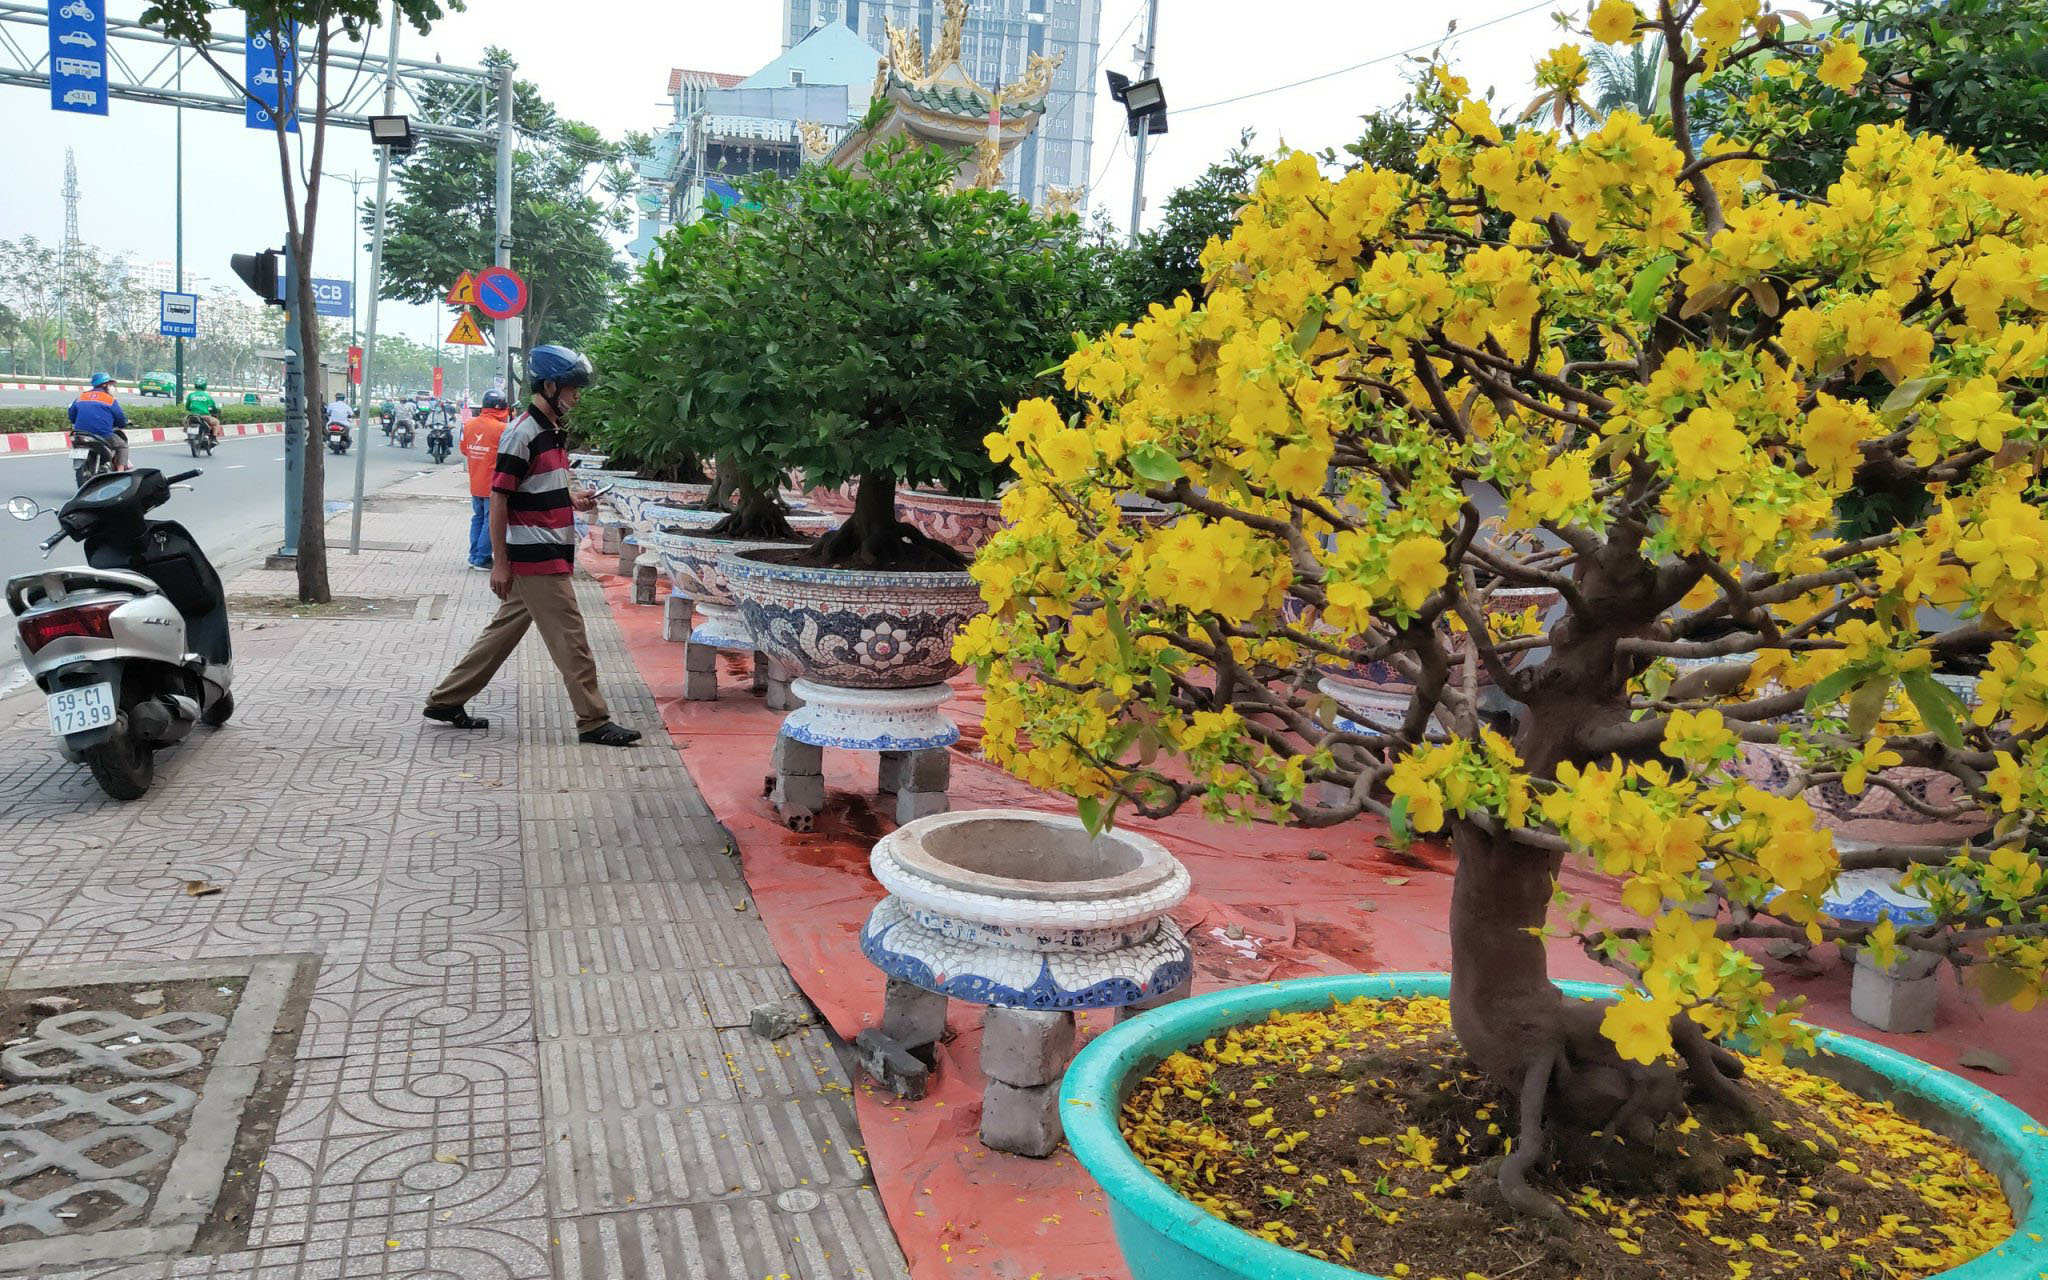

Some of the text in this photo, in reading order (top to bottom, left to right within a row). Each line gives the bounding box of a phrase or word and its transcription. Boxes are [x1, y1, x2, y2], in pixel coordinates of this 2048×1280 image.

[701, 115, 755, 139] COFFEE
[311, 283, 342, 301] SCB
[57, 687, 100, 712] 59-C1
[54, 704, 111, 732] 173.99
